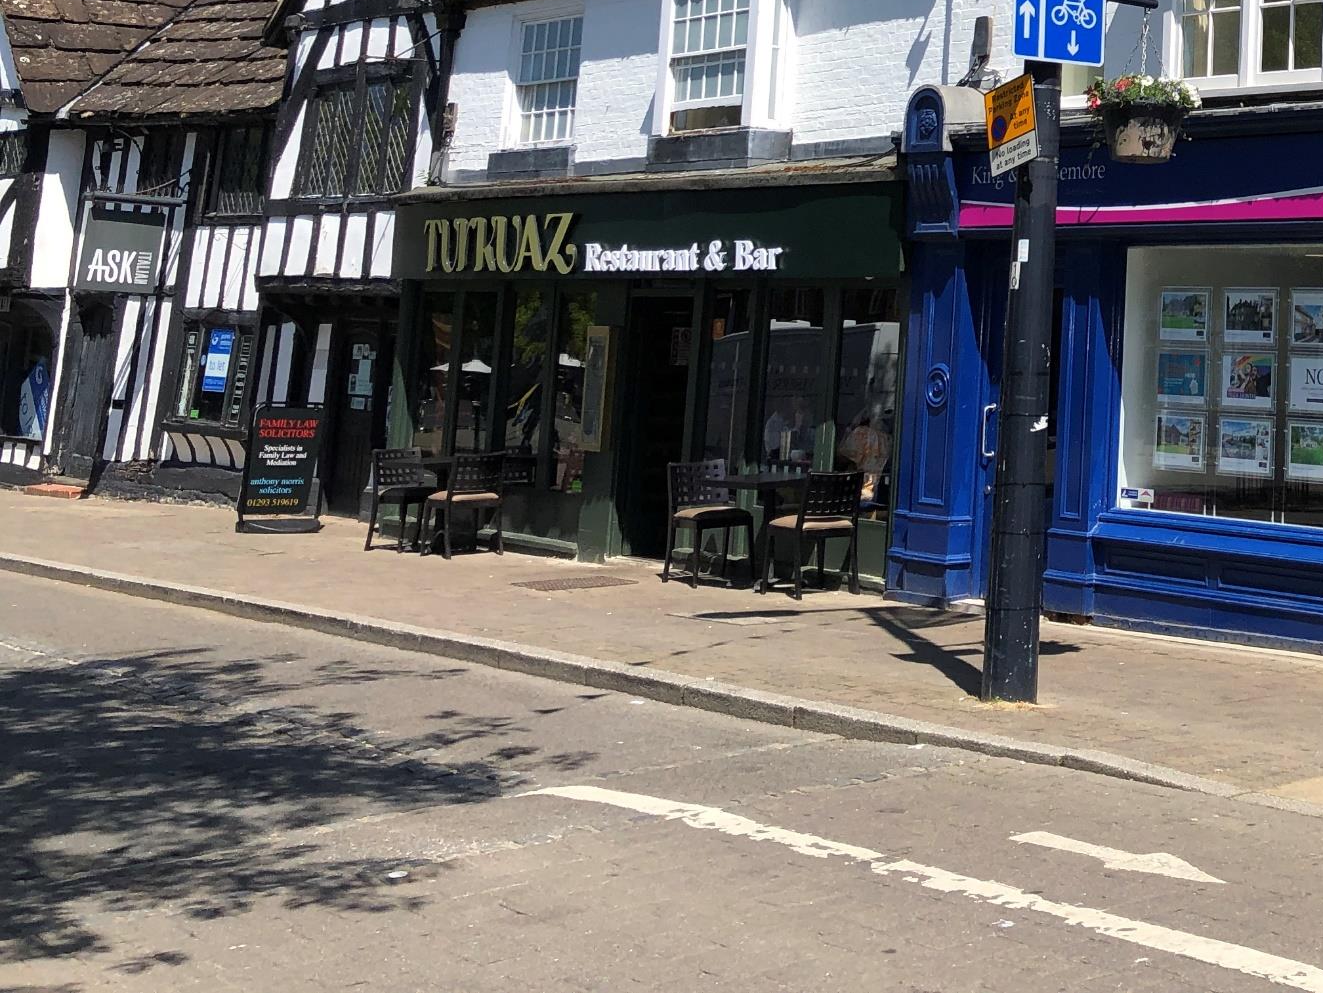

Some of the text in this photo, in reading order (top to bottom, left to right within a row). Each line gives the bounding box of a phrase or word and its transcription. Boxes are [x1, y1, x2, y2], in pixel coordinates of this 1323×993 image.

[988, 99, 1012, 115] Parking
[1018, 106, 1030, 117] any
[1013, 118, 1027, 129] time
[995, 138, 1031, 160] No loading
[996, 149, 1032, 170] at any time
[584, 241, 701, 272] Restaurant
[703, 239, 728, 271] &
[733, 239, 783, 271] Bar
[87, 248, 152, 285] ASK ITALIAN
[259, 418, 319, 428] FAMILY LAW
[259, 428, 316, 438] SOLICITORS
[264, 444, 296, 453] Specialists
[258, 451, 307, 460] Family Law and
[250, 476, 305, 486] anthony morris
[259, 486, 292, 494] solicitors
[246, 498, 270, 507] 01293
